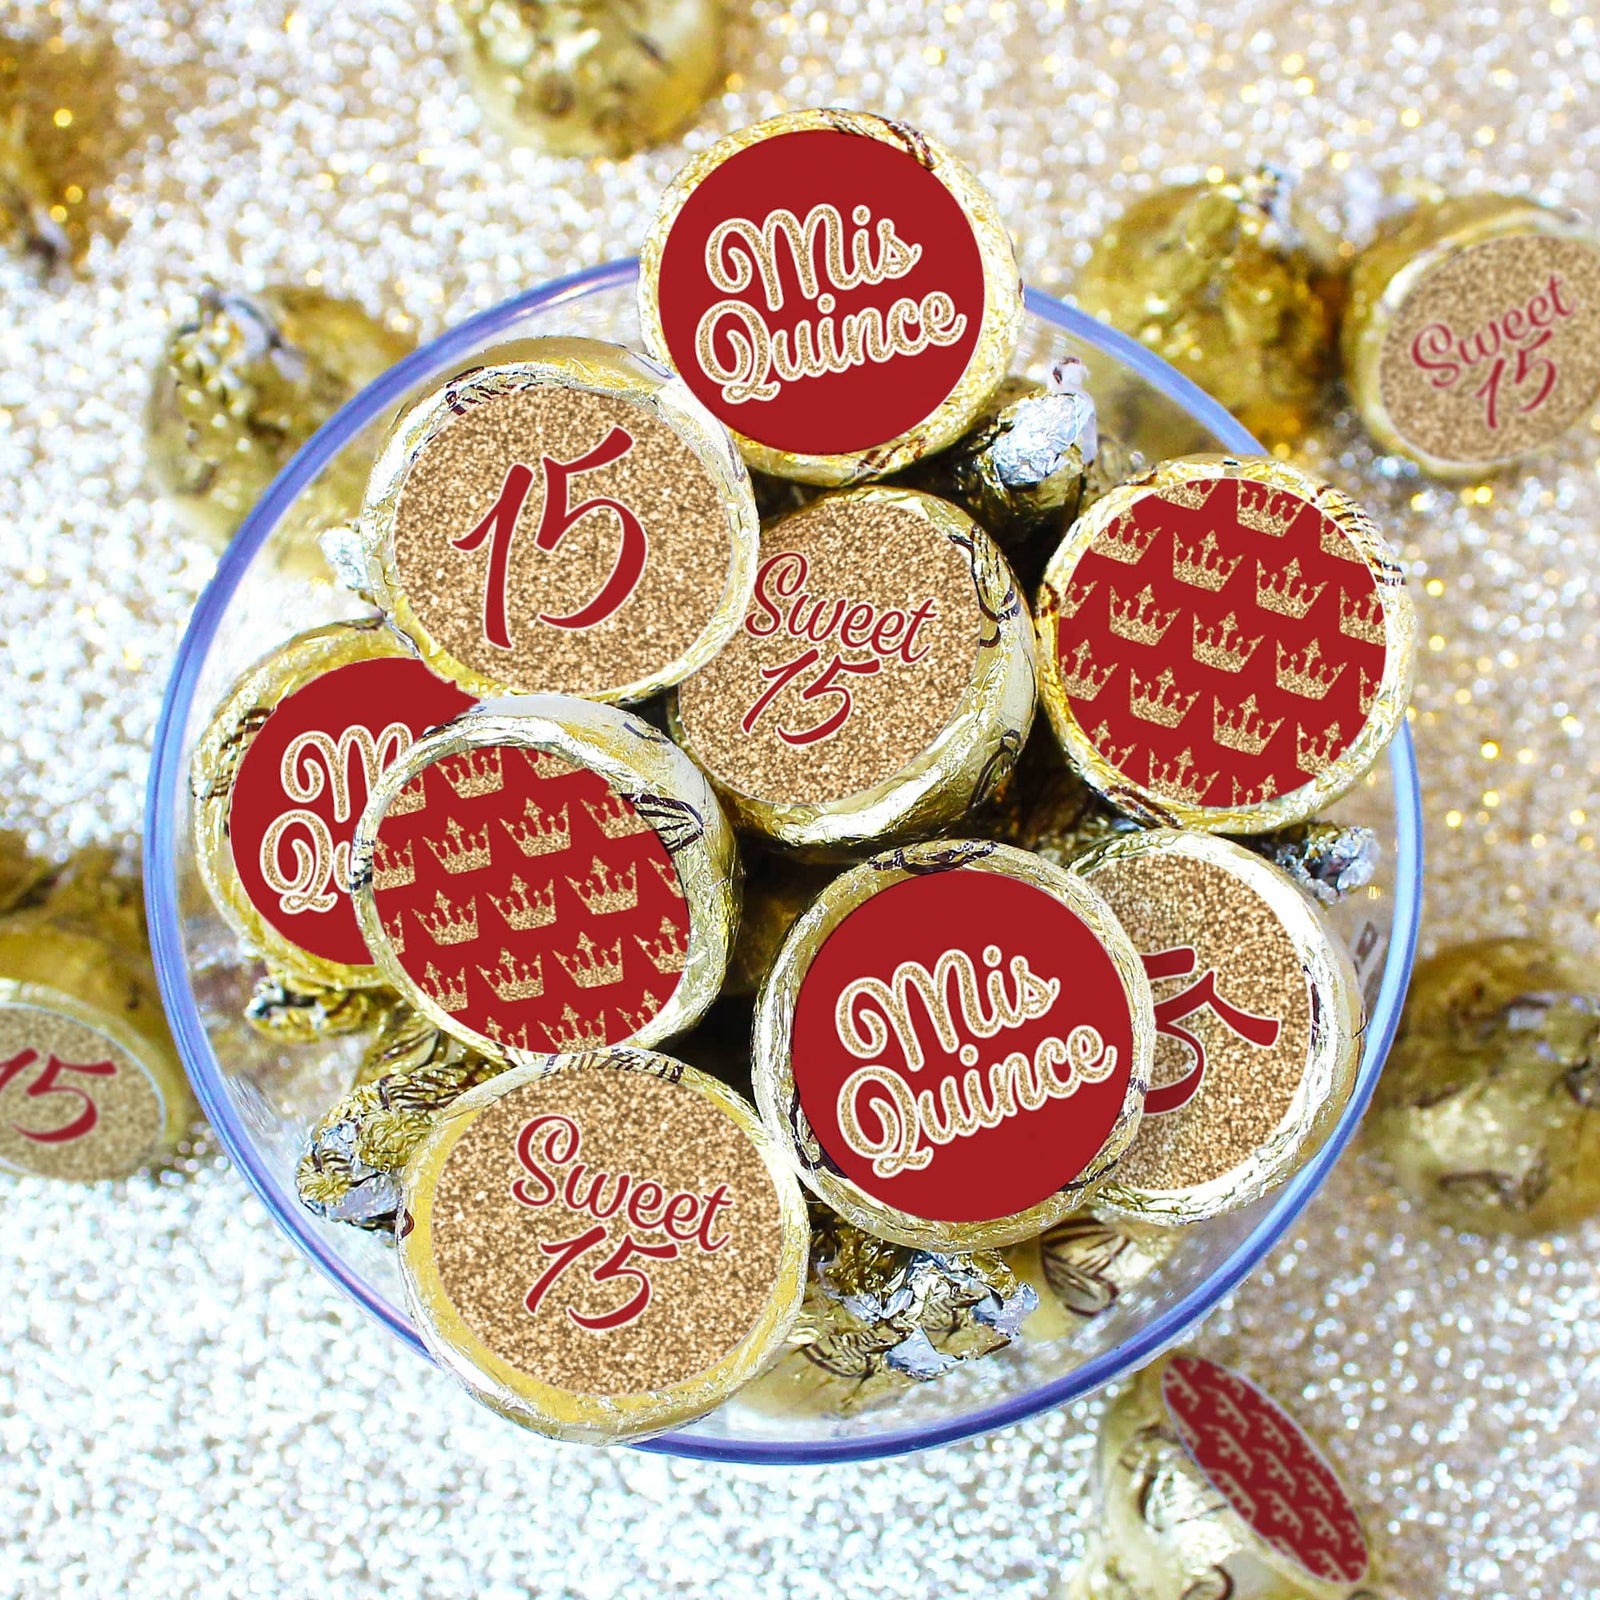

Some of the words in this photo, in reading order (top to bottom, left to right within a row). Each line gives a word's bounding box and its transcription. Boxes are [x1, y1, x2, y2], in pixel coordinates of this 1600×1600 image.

[706, 204, 922, 311] Mis
[695, 292, 967, 404] Quince
[1411, 274, 1576, 388] Sweet
[1475, 329, 1554, 429] 15
[452, 426, 647, 649] 15
[745, 552, 938, 664] Sweet
[742, 648, 880, 745] 15
[835, 945, 1060, 1071] Mis
[837, 1025, 1117, 1178] Quince
[512, 1114, 733, 1252] Sweet
[525, 1225, 678, 1331] 15
